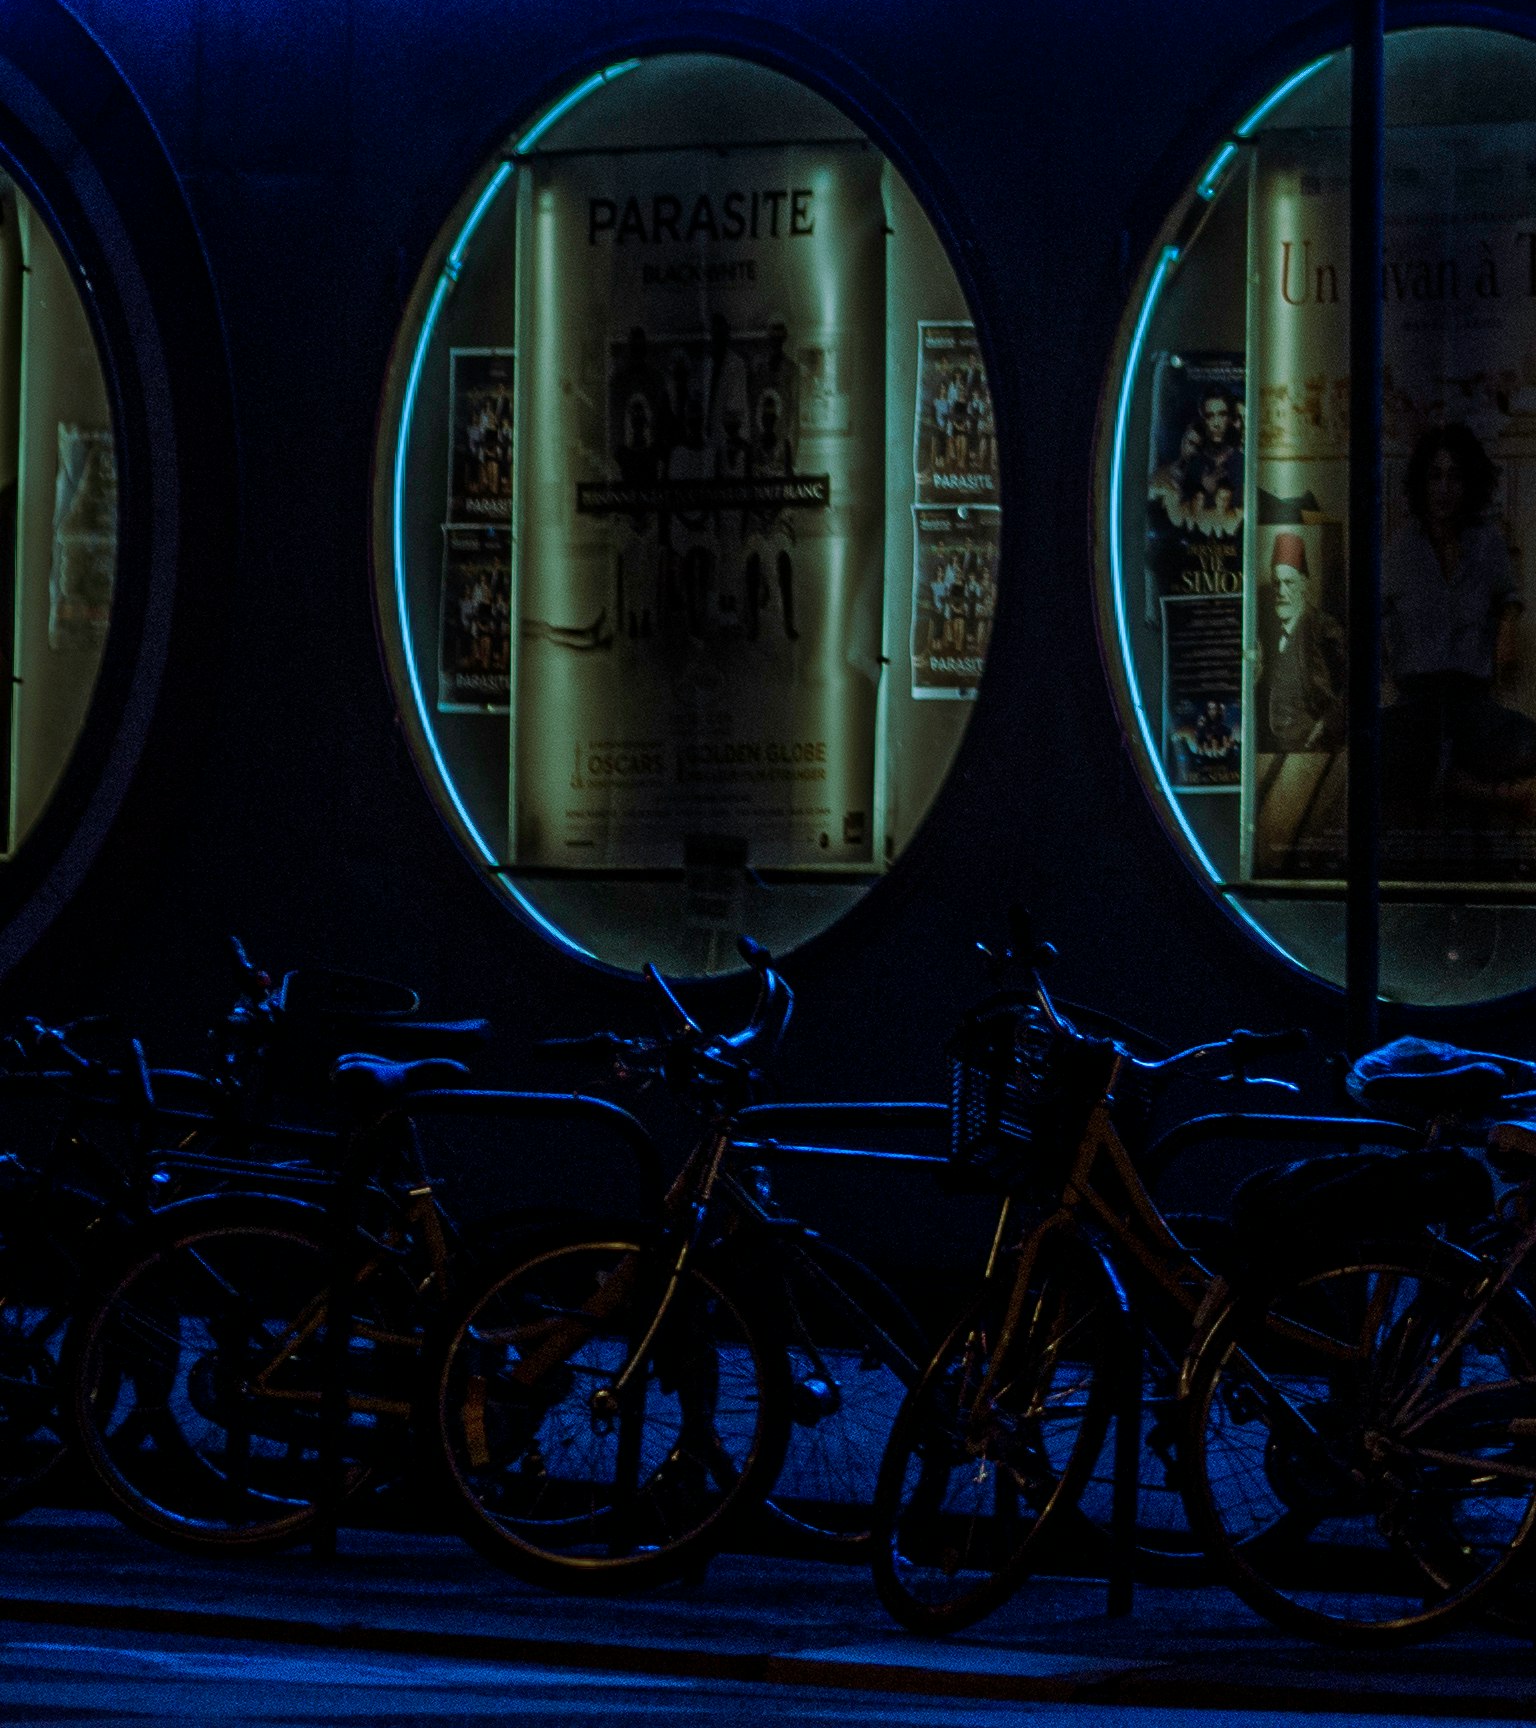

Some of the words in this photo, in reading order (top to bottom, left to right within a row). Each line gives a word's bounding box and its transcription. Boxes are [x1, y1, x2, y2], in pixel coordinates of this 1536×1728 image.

[588, 189, 814, 246] PARASITE
[1282, 240, 1340, 305] Un
[1379, 246, 1460, 301] ivan
[1475, 240, 1501, 299] à
[588, 753, 664, 776] OSCARS
[686, 743, 760, 765] GOLDEN
[766, 742, 827, 763] GLOBE
